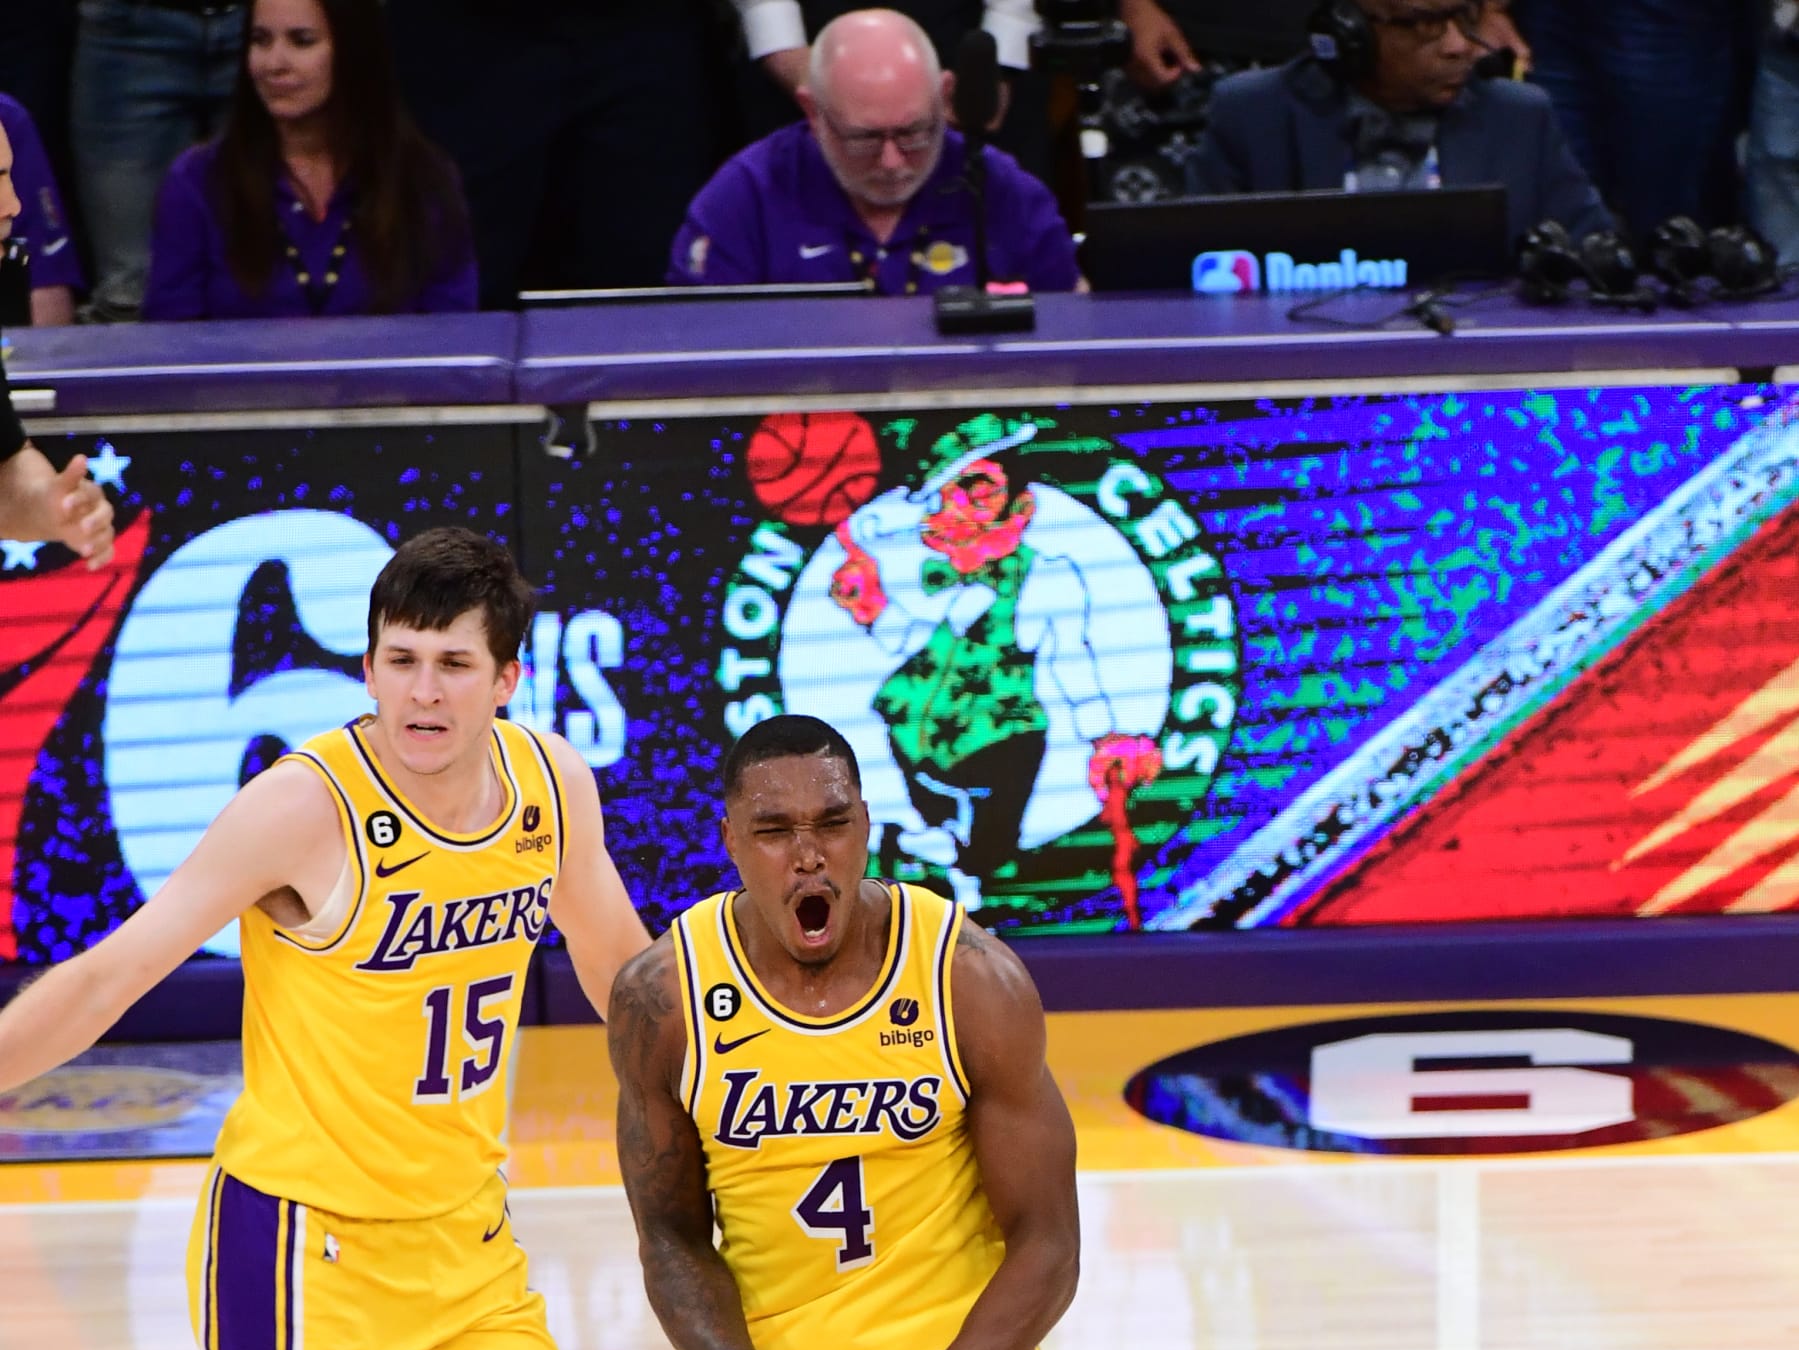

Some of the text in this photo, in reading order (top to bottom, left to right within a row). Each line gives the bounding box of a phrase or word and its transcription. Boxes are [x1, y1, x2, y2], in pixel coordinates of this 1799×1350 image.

[722, 462, 1237, 776] STON CELTICS
[371, 815, 395, 845] 6
[515, 832, 553, 854] bibigo
[353, 875, 553, 971] LAKERS
[413, 972, 517, 1104] 15
[712, 987, 734, 1018] 6
[879, 1029, 935, 1048] bibigo
[713, 1068, 945, 1150] LAKERS
[1310, 1027, 1636, 1140] 6
[789, 1154, 877, 1273] 4
